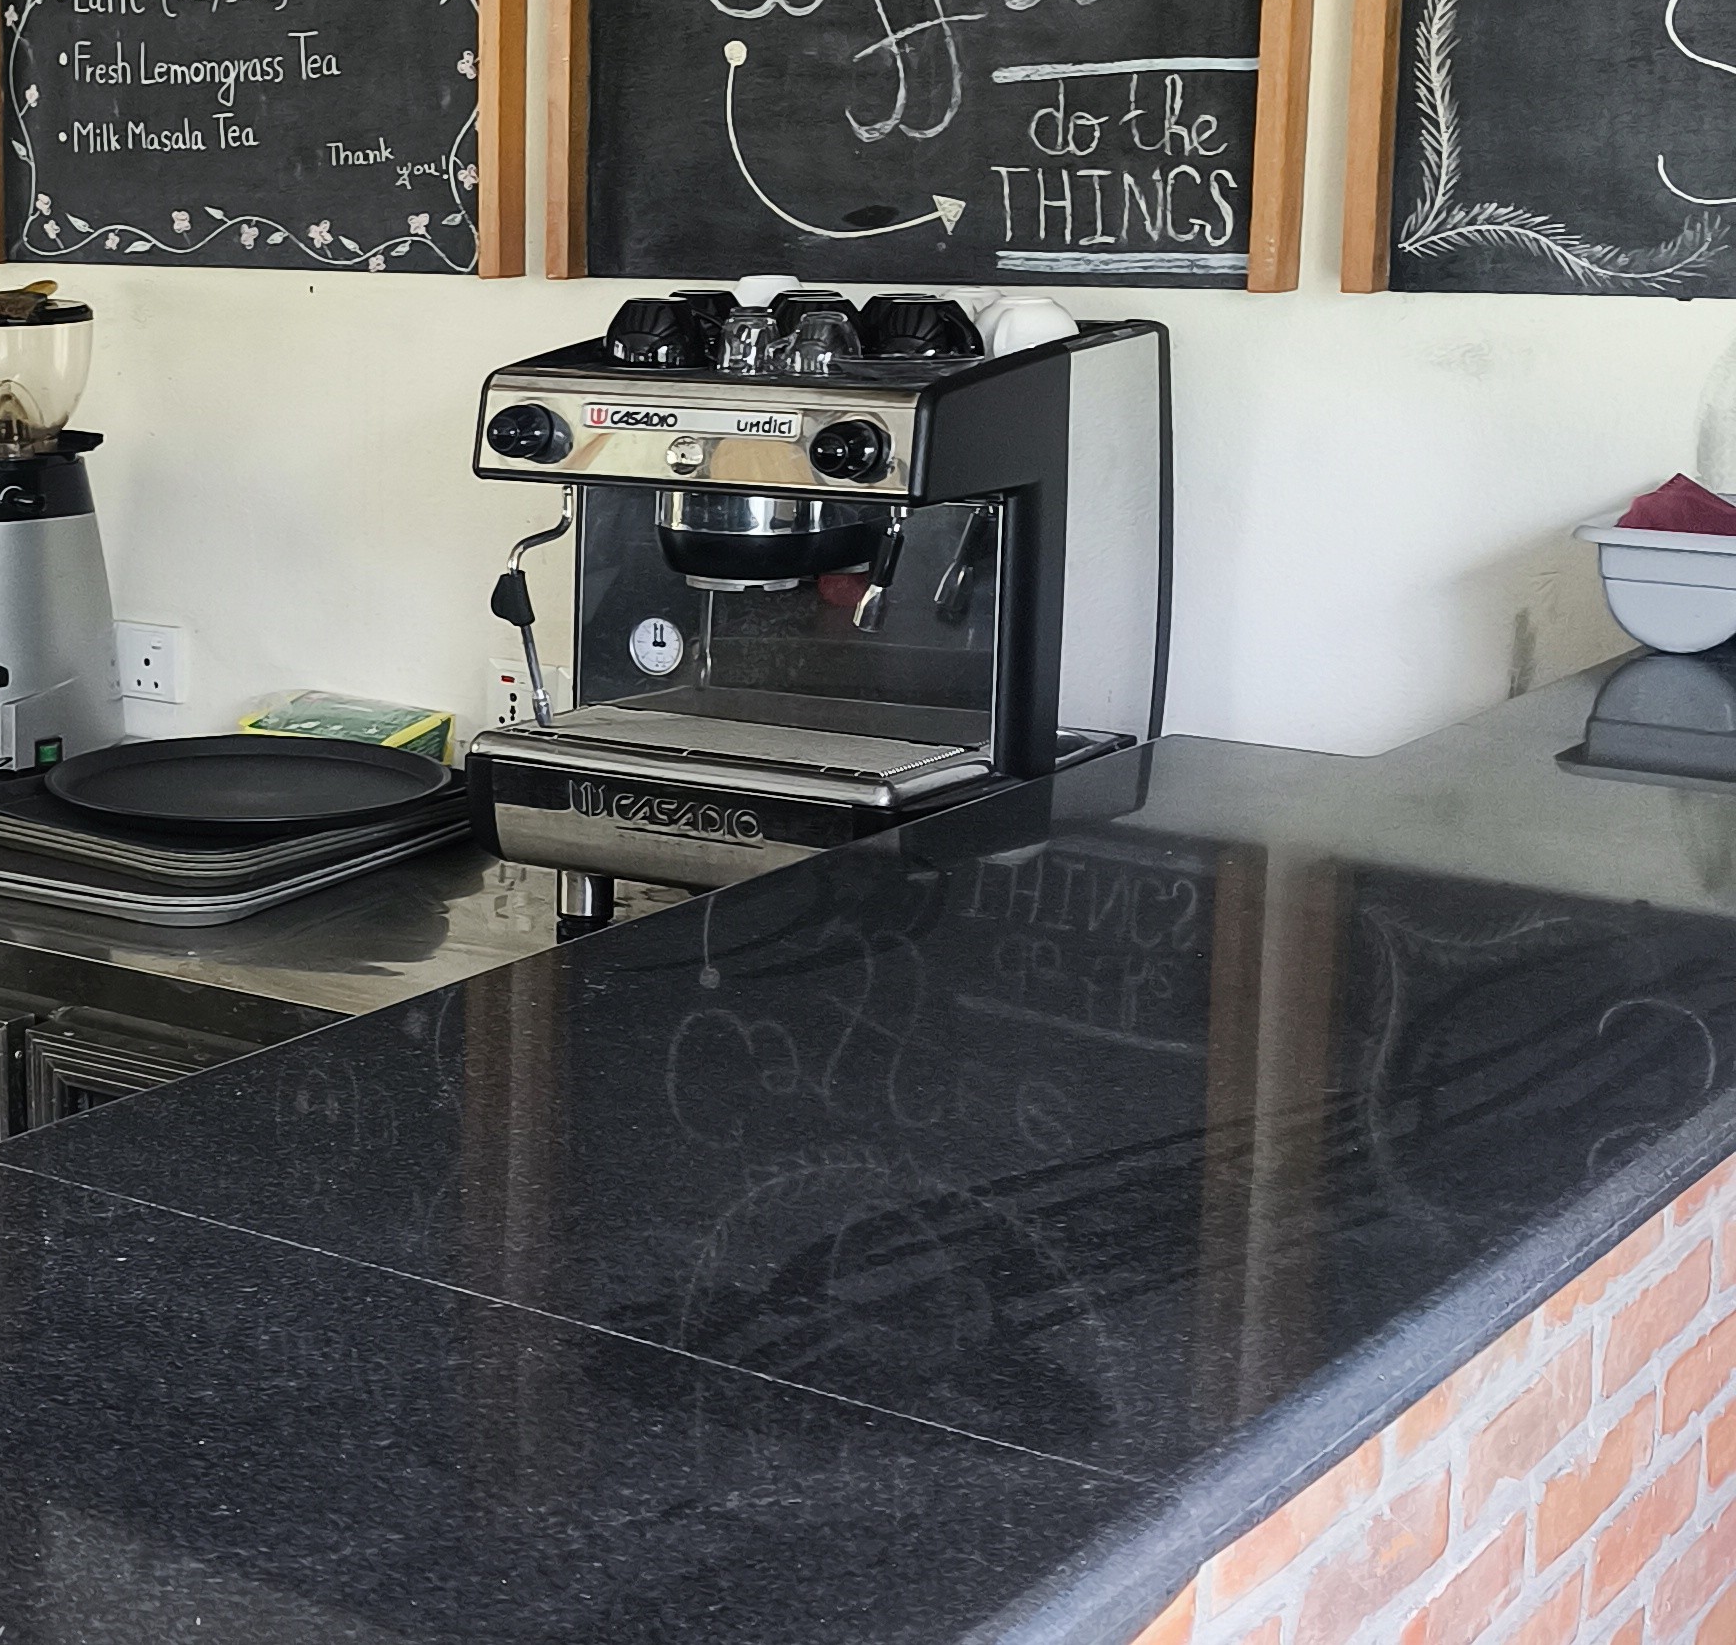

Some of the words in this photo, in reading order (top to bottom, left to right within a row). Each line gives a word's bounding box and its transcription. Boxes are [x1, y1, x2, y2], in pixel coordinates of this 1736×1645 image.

[74, 40, 132, 85] Fresh
[140, 42, 285, 106] Lemongrass
[288, 31, 341, 81] Tea
[73, 121, 121, 153] Milk
[128, 118, 207, 151] Masala
[213, 113, 259, 149] Tea
[1028, 79, 1110, 155] do
[1119, 73, 1228, 156] the
[326, 137, 394, 167] Thank
[396, 156, 449, 190] you!
[990, 164, 1238, 246] THINGS
[611, 411, 678, 428] CASADIO
[613, 793, 763, 841] CASADIO
